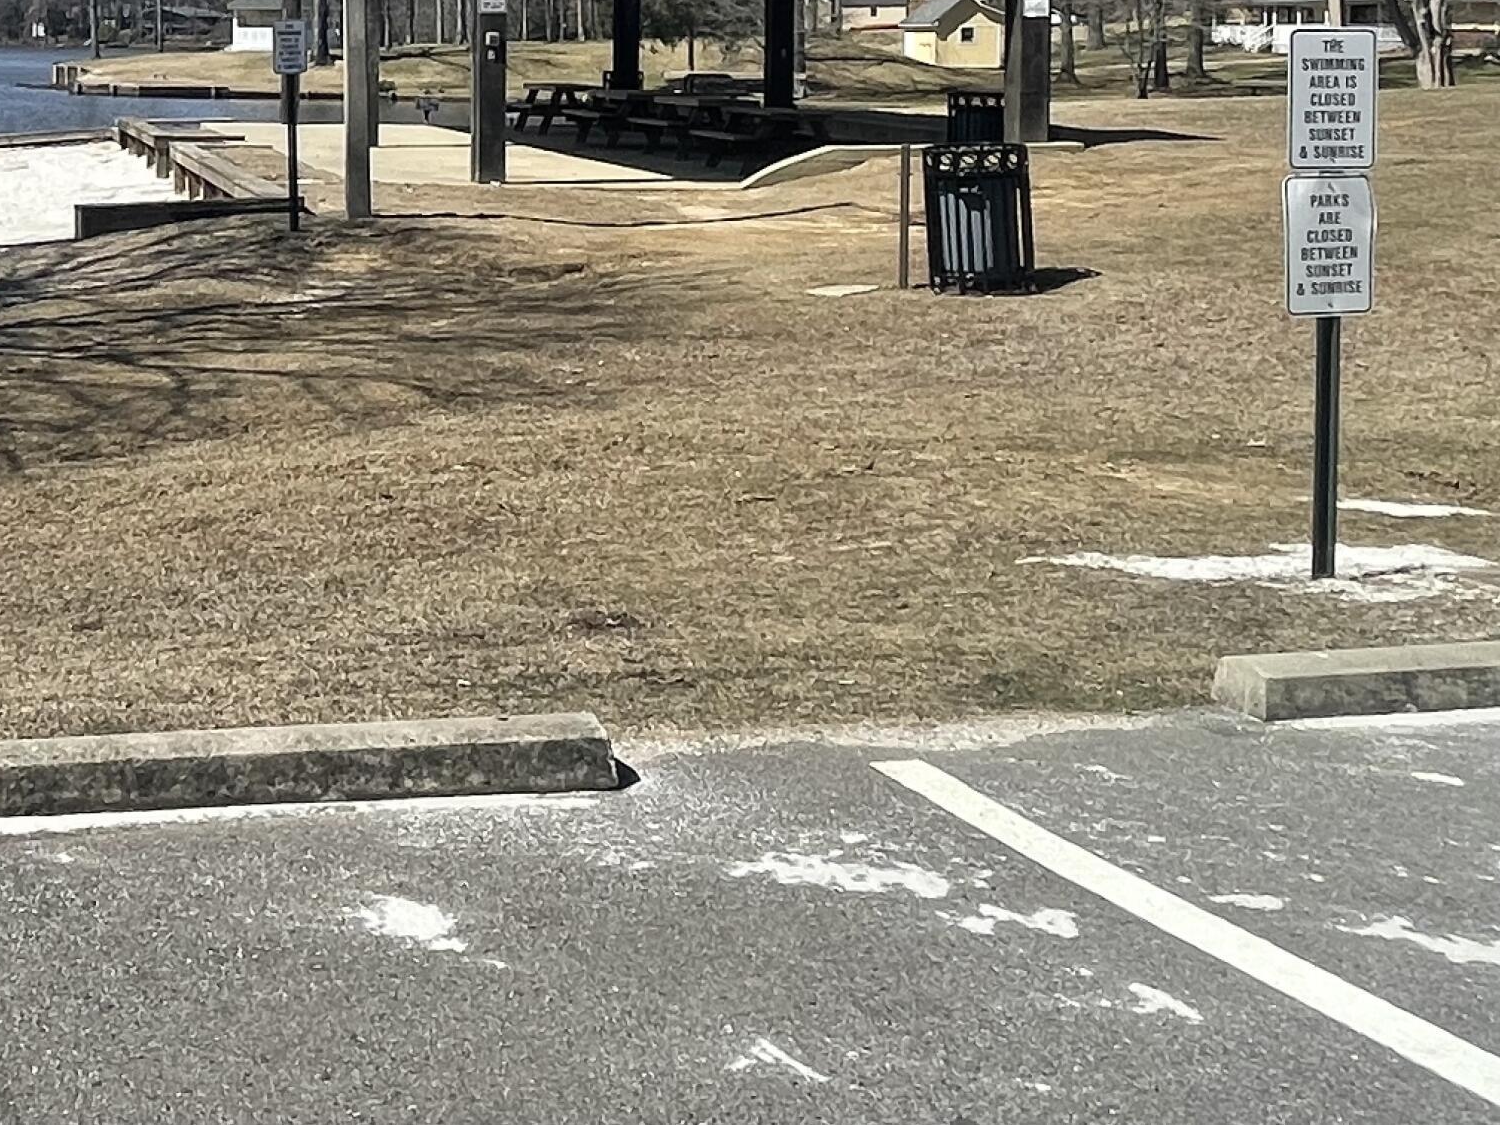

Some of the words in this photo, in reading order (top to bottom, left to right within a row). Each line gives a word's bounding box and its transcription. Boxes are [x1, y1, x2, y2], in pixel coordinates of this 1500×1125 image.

[1322, 39, 1344, 53] THE
[1302, 58, 1365, 71] SWIMMING
[1309, 75, 1340, 88] AREA
[1345, 75, 1357, 88] IS
[1310, 93, 1356, 106] CLOSED
[1304, 110, 1361, 123] BETWEEN
[1309, 127, 1355, 141] SUNSET
[1299, 146, 1308, 159] &
[1313, 145, 1365, 159] SUNRISE
[1310, 194, 1350, 207] PARKS
[1318, 211, 1341, 224] ARE
[1307, 228, 1353, 243] CLOSED
[1301, 246, 1358, 261] BETWEEN
[1306, 263, 1352, 277] SUNSET
[1297, 282, 1305, 296] &
[1312, 280, 1362, 295] SUNRISE
